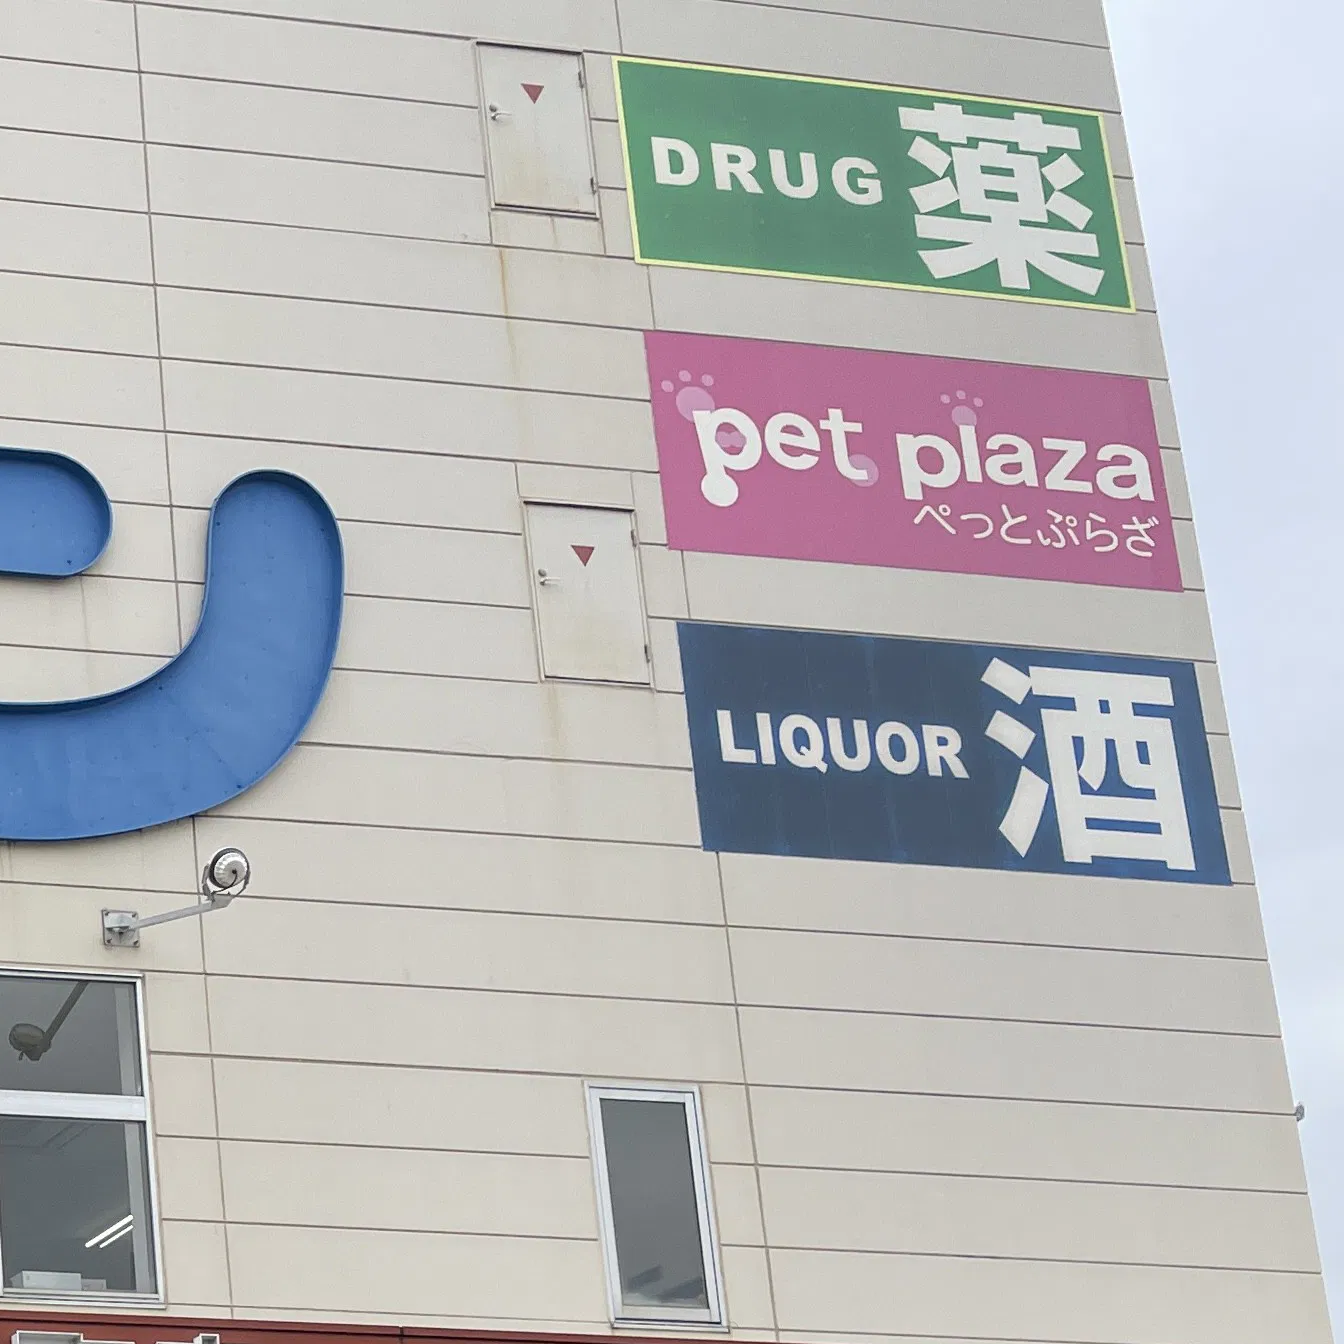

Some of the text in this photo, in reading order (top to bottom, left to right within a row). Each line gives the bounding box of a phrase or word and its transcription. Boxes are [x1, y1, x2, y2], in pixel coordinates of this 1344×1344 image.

[651, 101, 1106, 297] DRUG 薬
[692, 405, 1157, 508] pet plaza
[912, 504, 1159, 559] ぺっとぷらざ
[716, 656, 1197, 873] LIQUOR 酒
